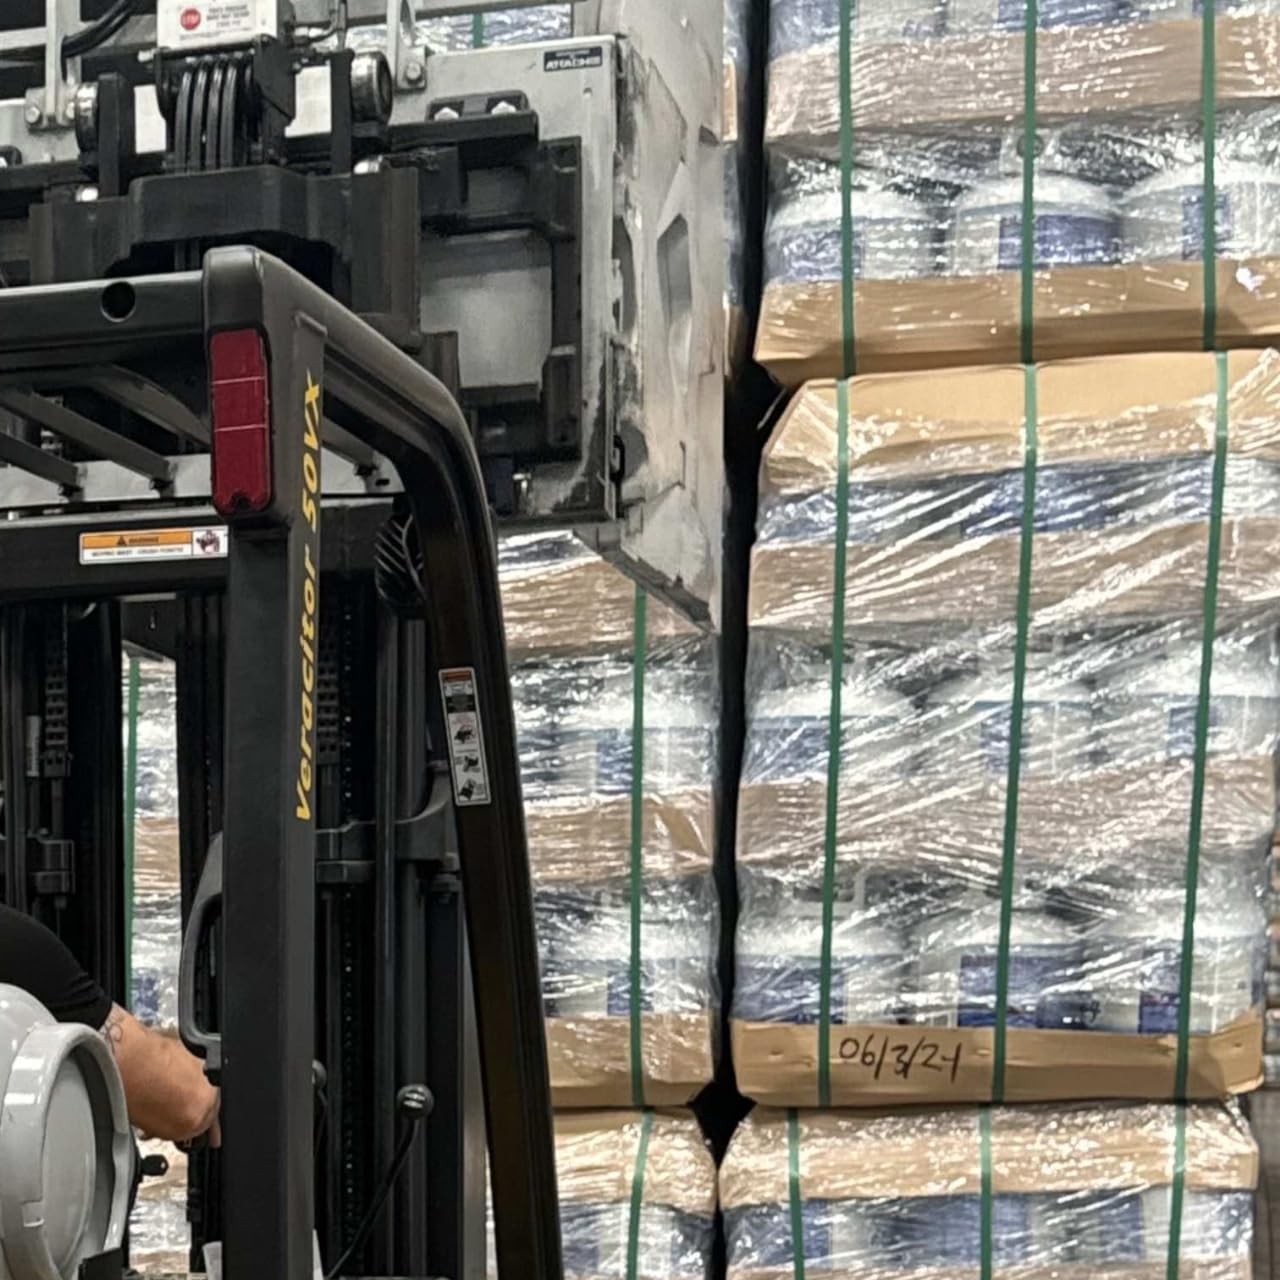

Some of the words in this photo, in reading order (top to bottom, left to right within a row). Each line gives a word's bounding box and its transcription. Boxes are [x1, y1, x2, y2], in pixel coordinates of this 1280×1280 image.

[302, 367, 320, 533] 50VX
[296, 544, 318, 821] Veracitor
[838, 1033, 962, 1084] 06/3/24
